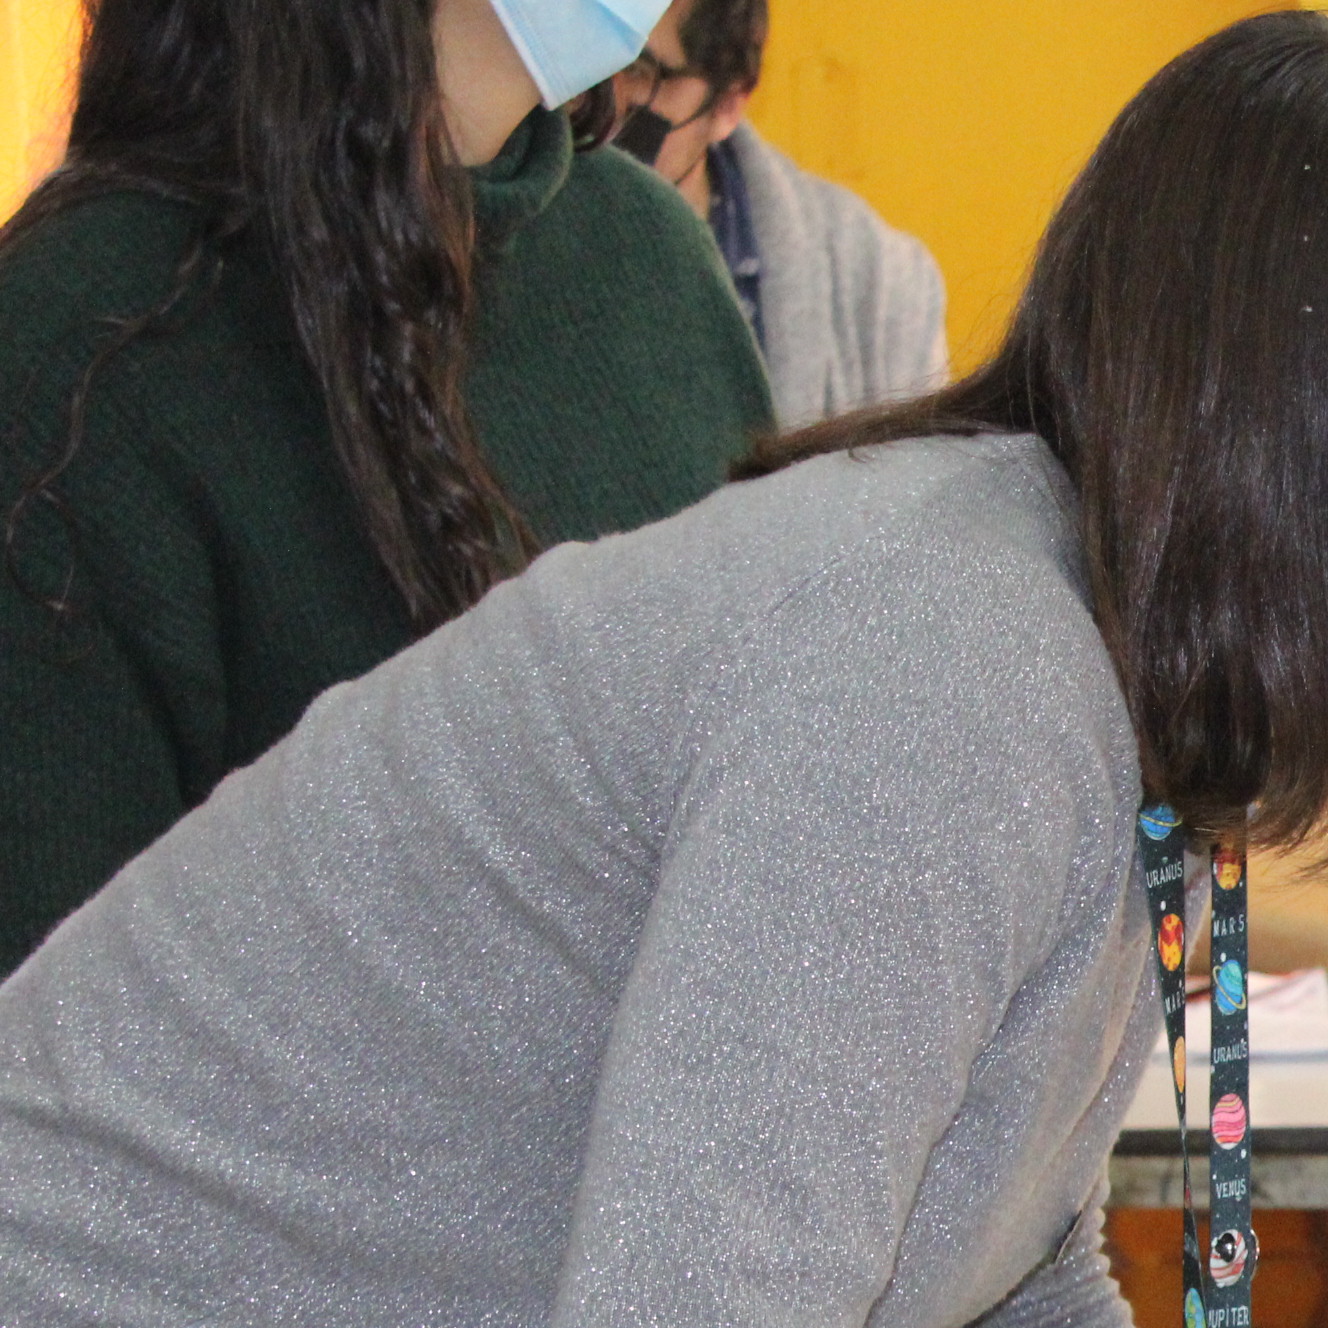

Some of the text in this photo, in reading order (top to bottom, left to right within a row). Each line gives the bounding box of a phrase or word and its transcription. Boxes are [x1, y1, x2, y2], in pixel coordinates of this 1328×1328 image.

[1146, 862, 1183, 888] URANUS
[1213, 915, 1245, 937] MARS
[1213, 1041, 1248, 1064] URANUS
[1215, 1179, 1247, 1199] VENUS
